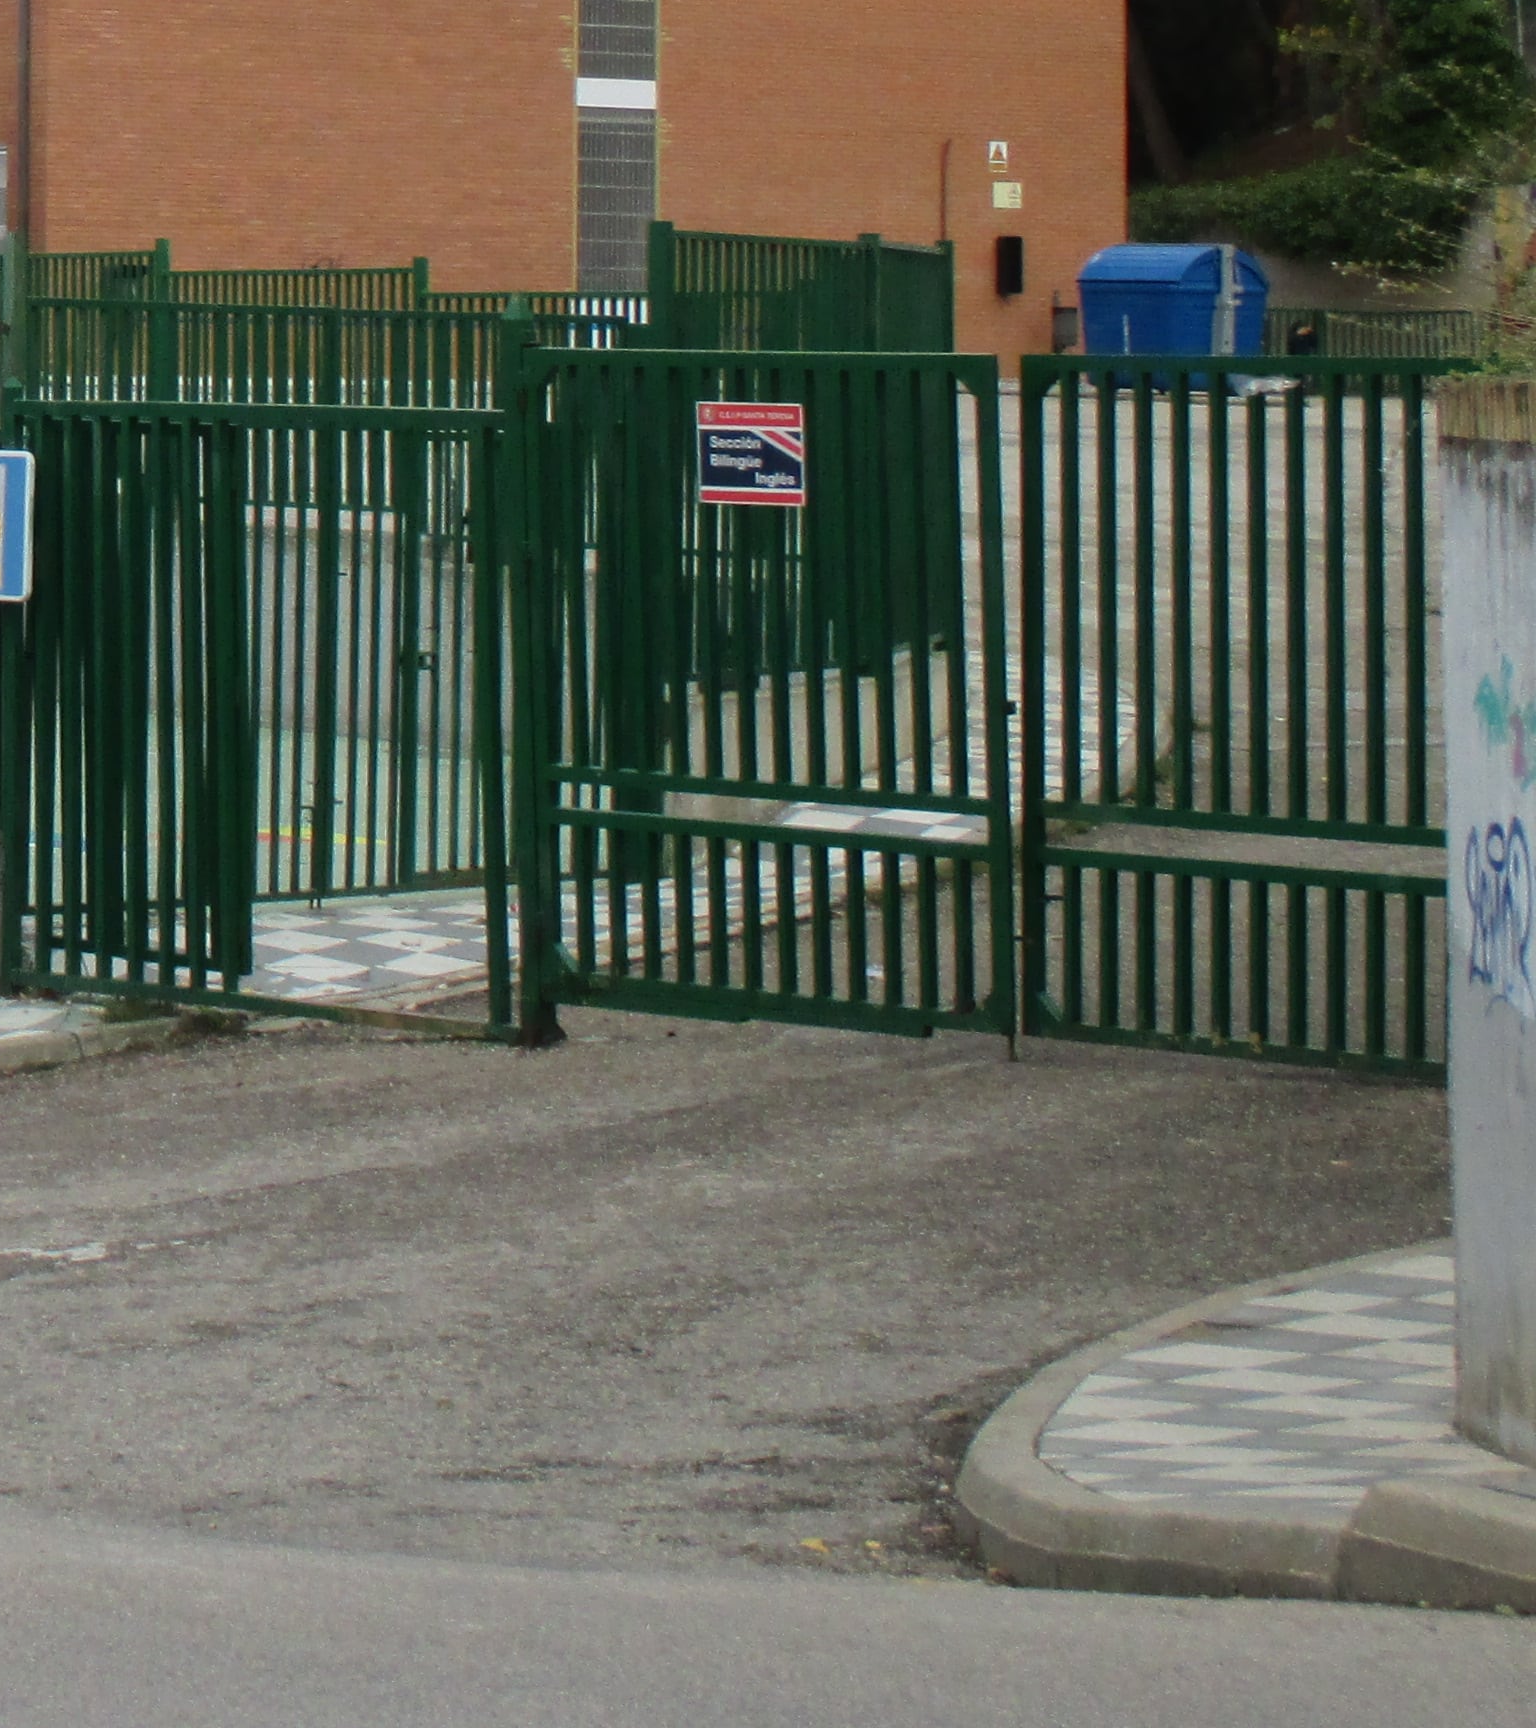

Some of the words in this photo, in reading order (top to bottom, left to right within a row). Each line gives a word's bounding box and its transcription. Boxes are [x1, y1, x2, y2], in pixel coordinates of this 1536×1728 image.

[709, 435, 762, 450] Sección
[709, 453, 763, 471] Bilingüe
[754, 471, 796, 488] Inglés
